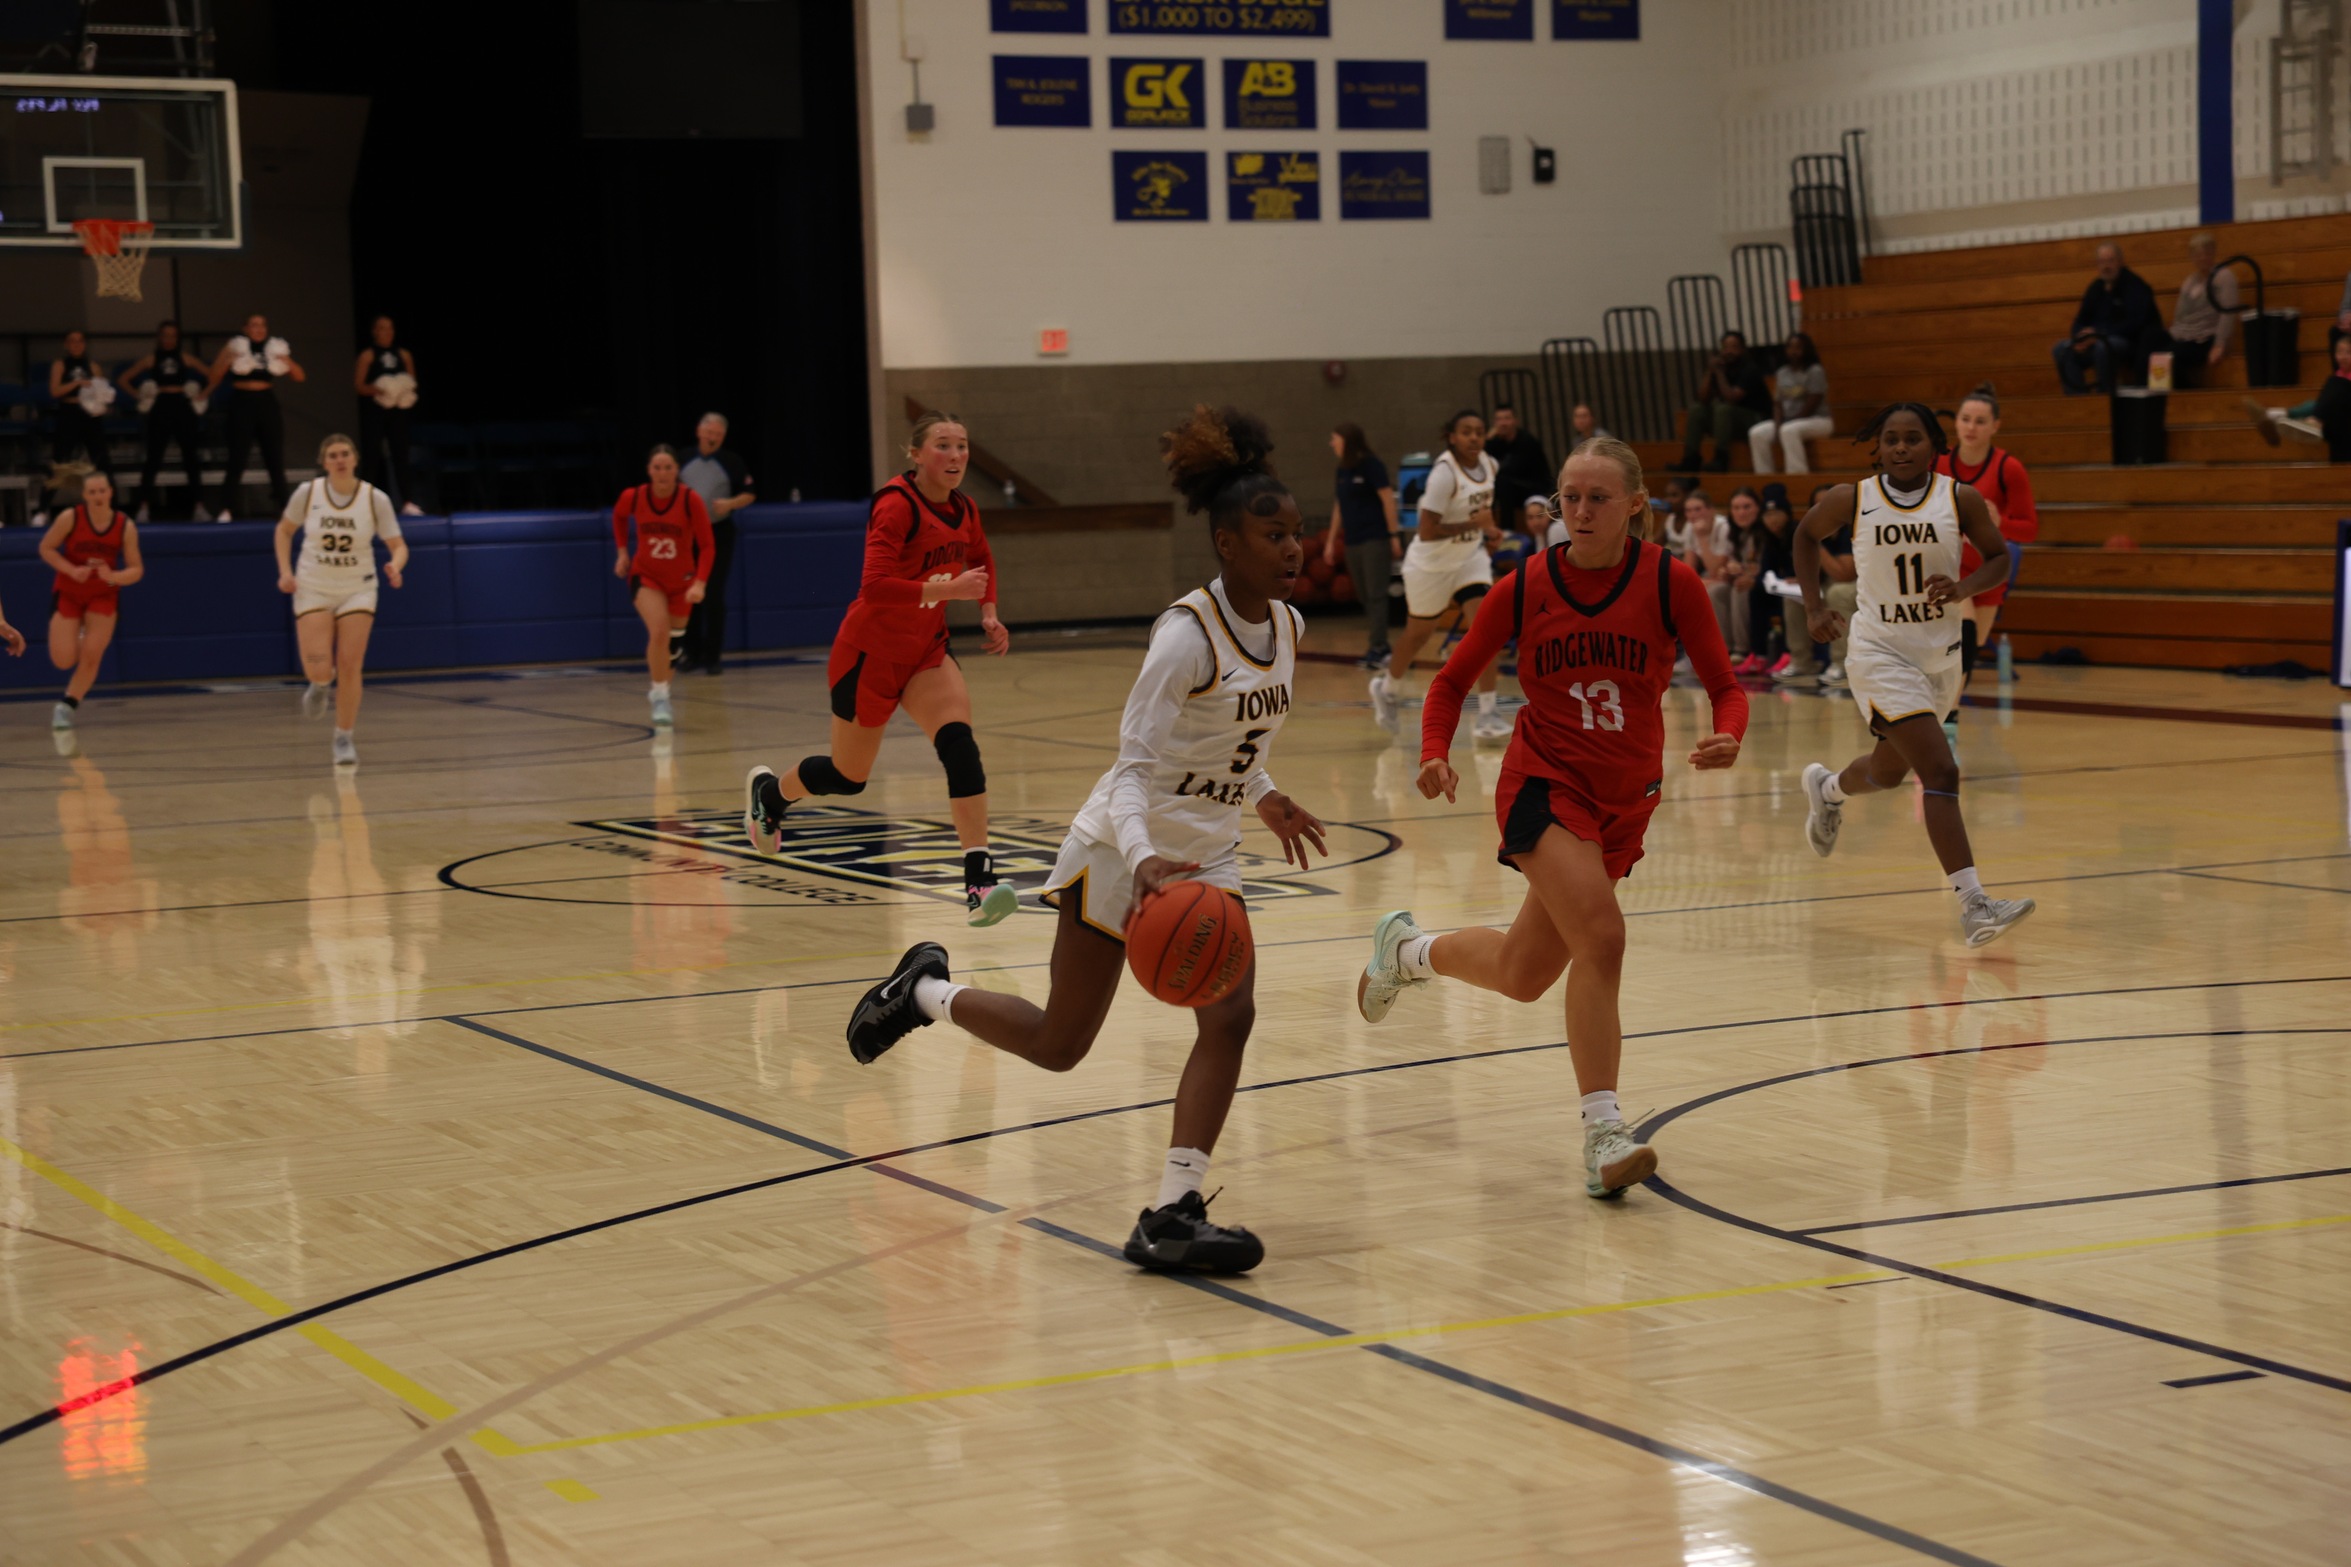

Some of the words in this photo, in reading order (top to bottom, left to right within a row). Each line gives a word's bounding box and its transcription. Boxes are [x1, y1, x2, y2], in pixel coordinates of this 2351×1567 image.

[1118, 5, 1200, 29] ($1,000
[1203, 6, 1235, 29] TO
[1238, 7, 1318, 33] $2,499)
[1122, 63, 1194, 109] GK
[320, 516, 357, 530] IOWA
[1874, 522, 1940, 546] IOWA
[322, 533, 354, 553] 32
[646, 536, 679, 561] 23
[1893, 552, 1925, 596] 11
[1880, 602, 1945, 624] LAKES
[1534, 630, 1649, 679] RIDGEWATER
[1233, 683, 1290, 722] IOWA
[1568, 678, 1626, 733] 13
[1229, 728, 1272, 775] 5
[718, 872, 880, 904] COLLEGE
[1167, 912, 1219, 992] SPALDING
